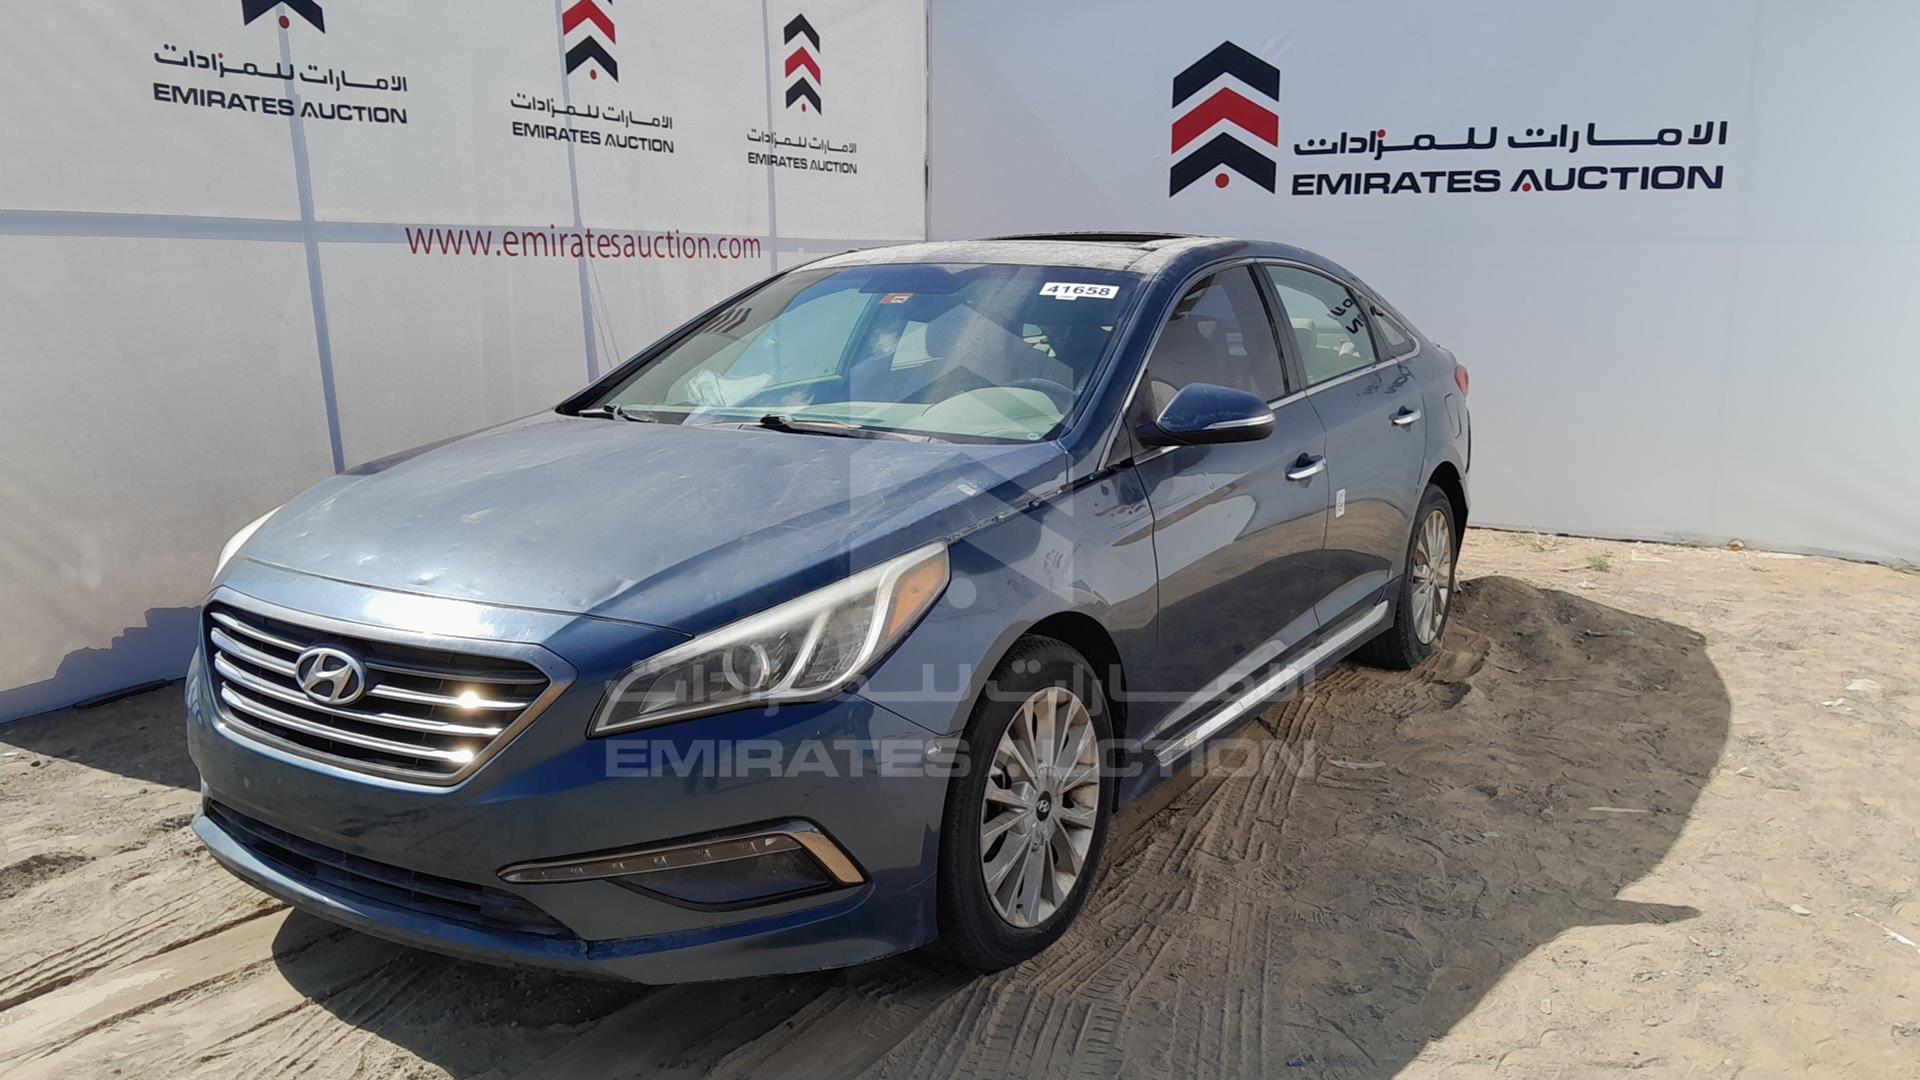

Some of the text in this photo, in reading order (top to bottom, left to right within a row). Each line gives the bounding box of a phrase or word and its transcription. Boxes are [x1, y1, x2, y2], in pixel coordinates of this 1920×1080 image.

[153, 82, 408, 124] EMIRATES AUCTION
[512, 121, 674, 154] EMIRATES AUCTION
[747, 152, 857, 175] EMIRATES AUCTION
[1292, 165, 1724, 196] EMIRATES AUCTION
[404, 224, 762, 260] www.emiratesauction.com
[1046, 284, 1111, 297] 41658
